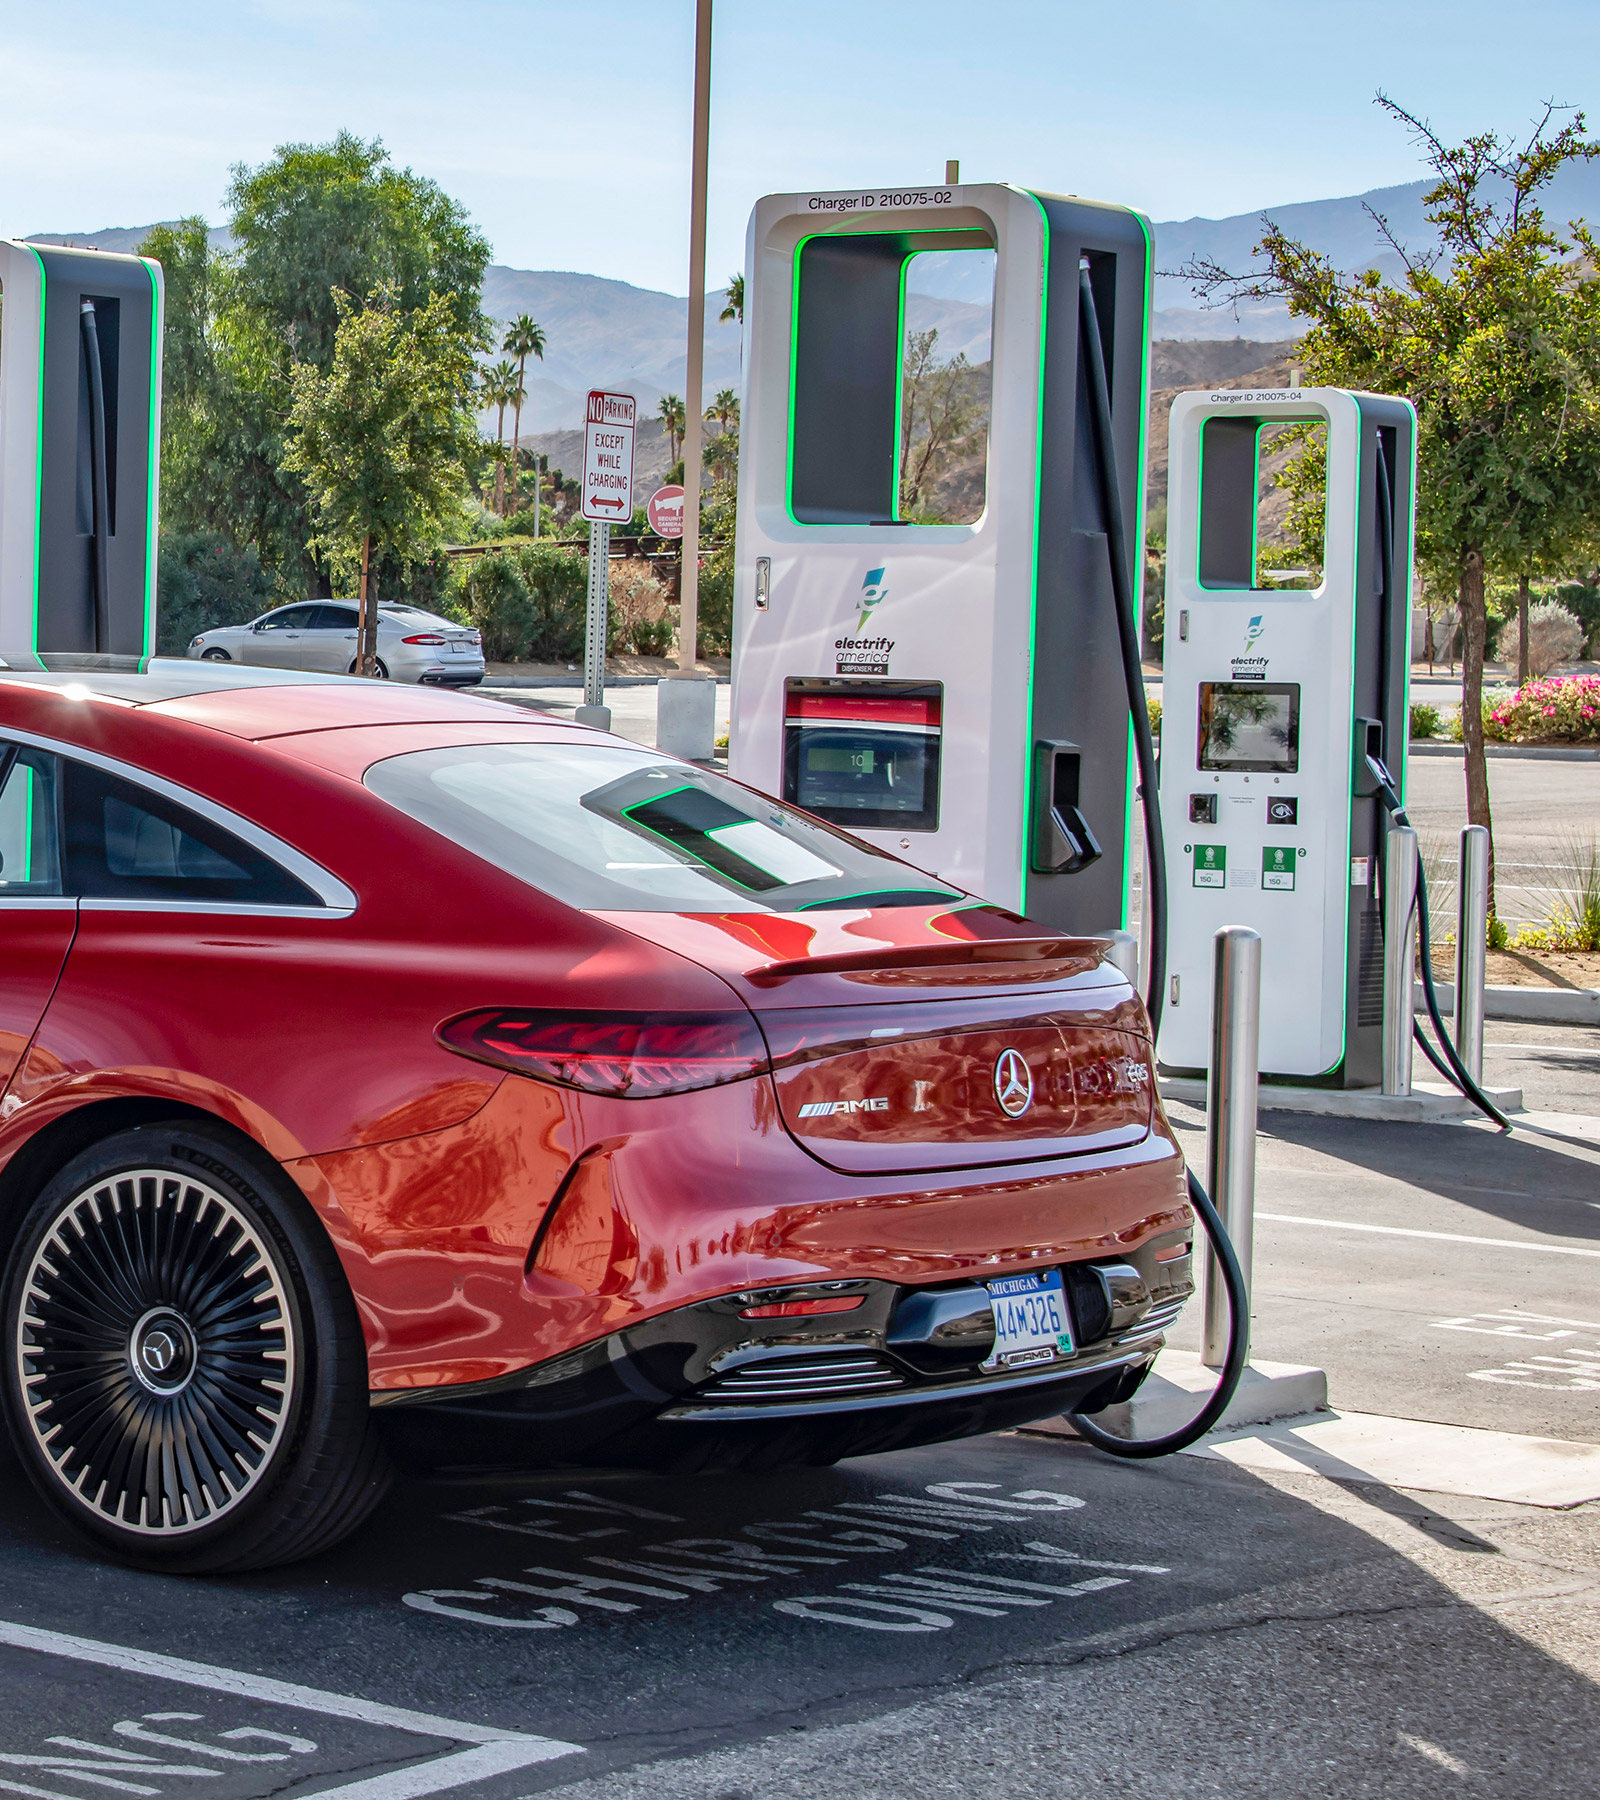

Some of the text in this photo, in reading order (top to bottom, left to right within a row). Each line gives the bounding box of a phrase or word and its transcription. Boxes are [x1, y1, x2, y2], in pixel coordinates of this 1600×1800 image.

[808, 191, 952, 212] Charger ID 210075-02
[1210, 392, 1302, 404] Charger ID 210075-04
[588, 397, 633, 421] NO PARKING
[595, 432, 625, 450] EXCEPT
[597, 453, 621, 470] WHILE
[588, 472, 628, 490] CHARGING
[834, 636, 896, 653] electrify
[835, 651, 890, 663] america
[1230, 657, 1269, 666] electrify
[841, 664, 872, 672] DISPENSER
[831, 1097, 890, 1115] AMG
[193, 1152, 265, 1211] MICHELIN
[991, 1277, 1040, 1295] MICHIGAN
[996, 1294, 1061, 1342] 44M326
[1022, 1349, 1052, 1361] AMG
[436, 1489, 687, 1543] EV
[401, 1481, 1087, 1629] CHARGING
[773, 1540, 1172, 1631] ONLY
